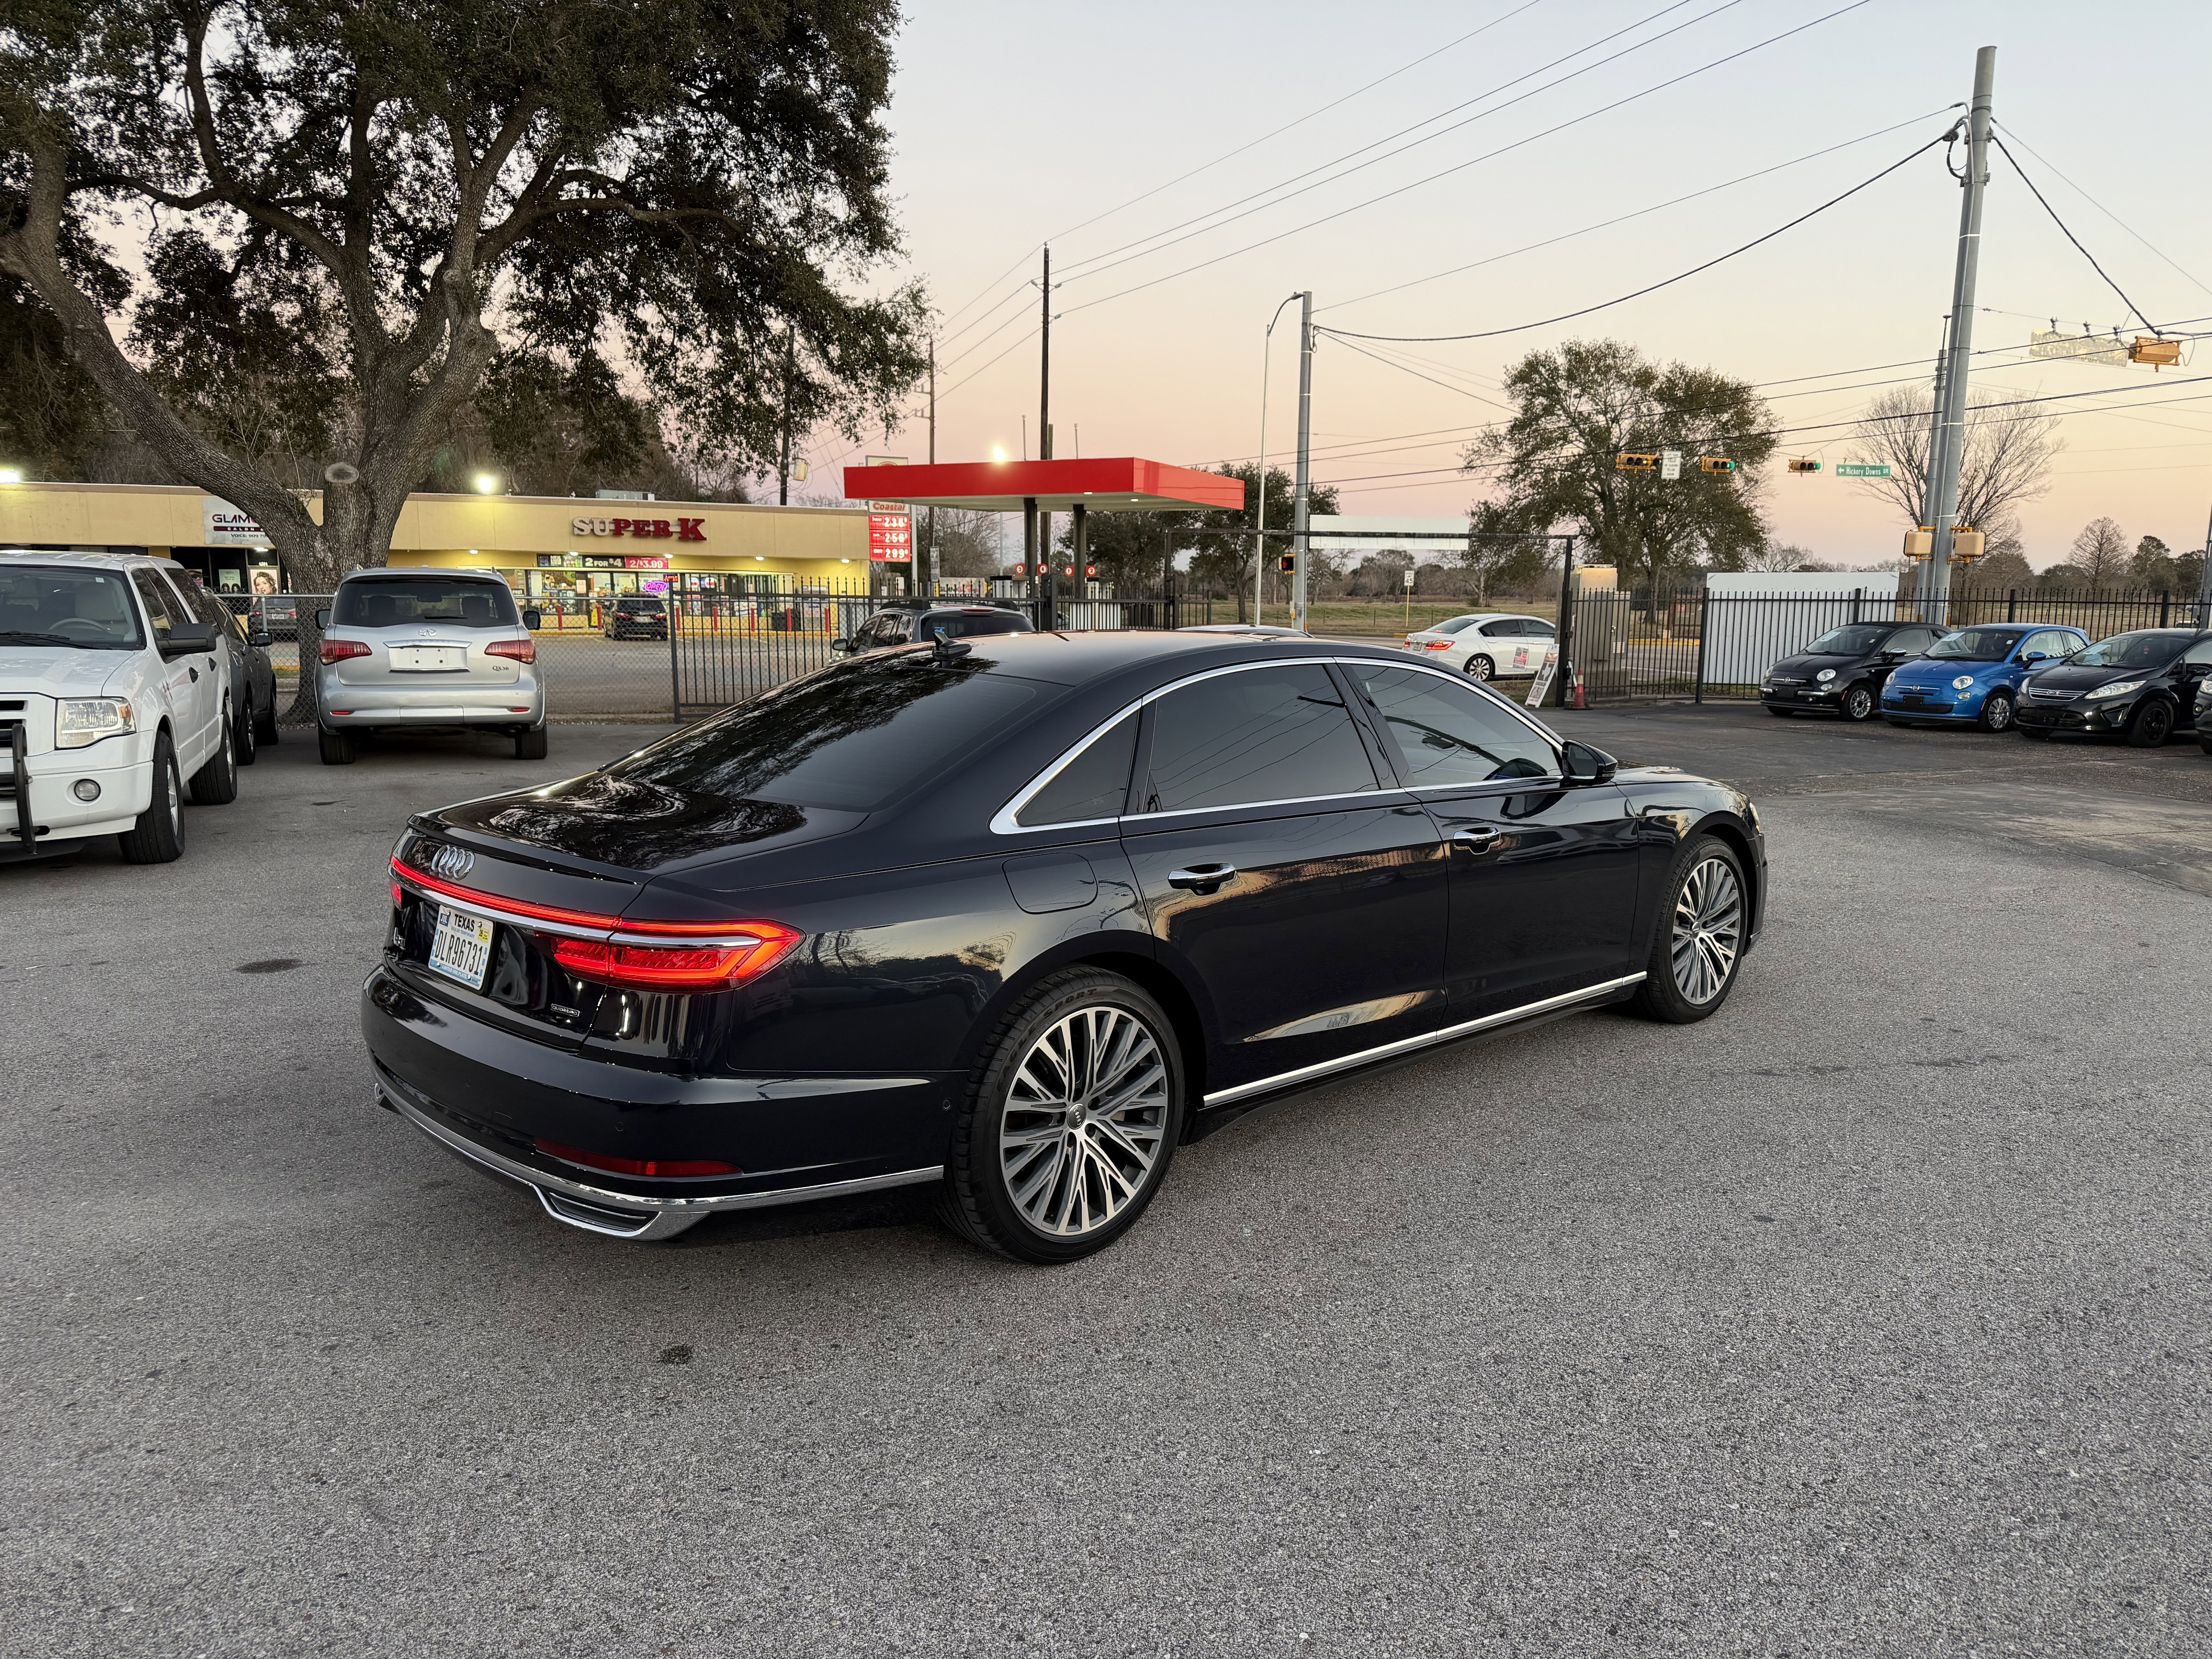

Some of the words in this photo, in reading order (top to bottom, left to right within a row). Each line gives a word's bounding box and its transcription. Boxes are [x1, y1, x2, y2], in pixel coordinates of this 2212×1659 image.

[1846, 466, 1863, 476] Hickory
[1865, 467, 1881, 475] Downs
[873, 502, 905, 511] Coastal
[573, 517, 673, 538] SUPER
[677, 518, 707, 541] K
[585, 557, 593, 567] 2
[609, 558, 622, 567] $4
[646, 582, 666, 590] OPEN
[1681, 860, 1691, 879] P7
[454, 914, 475, 932] TEXAS
[434, 930, 483, 975] DLR96731
[996, 1022, 1036, 1093] EAGLE
[1043, 988, 1097, 1019] SPORT
